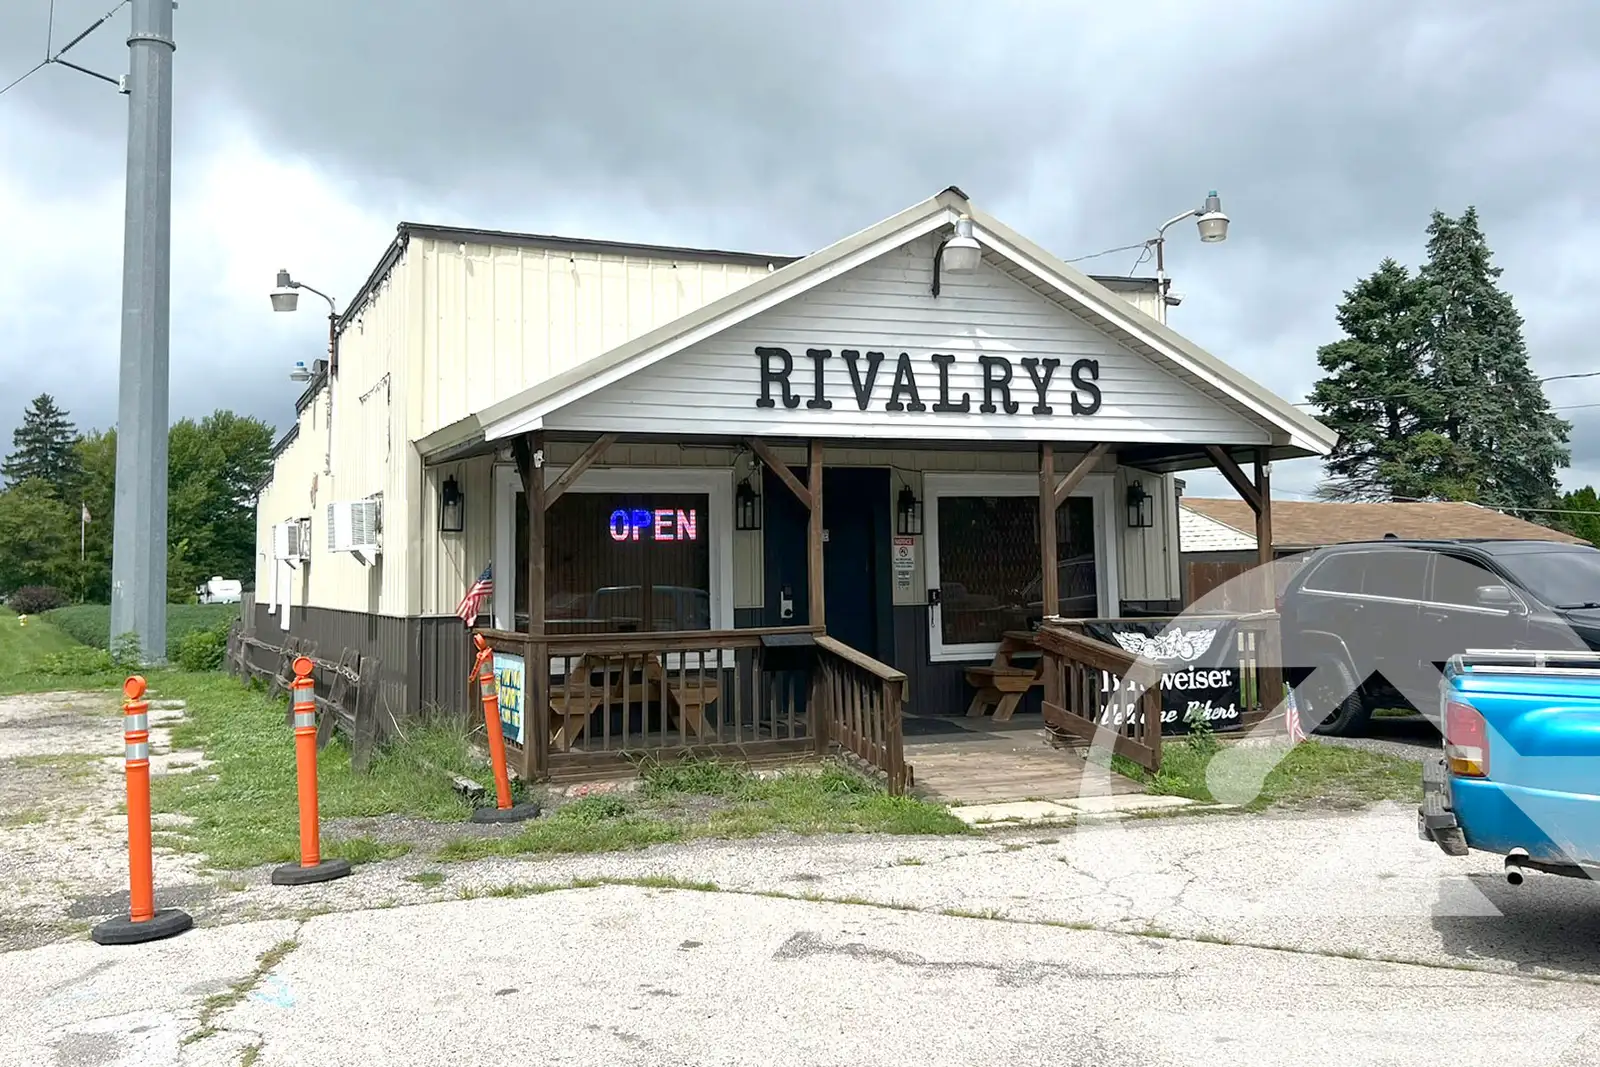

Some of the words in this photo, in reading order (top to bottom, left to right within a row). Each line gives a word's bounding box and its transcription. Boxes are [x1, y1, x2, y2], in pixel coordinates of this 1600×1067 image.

[755, 346, 1101, 416] RIVALRYS
[609, 508, 697, 541] OPEN
[1100, 665, 1231, 693] Bweiser
[1093, 703, 1178, 726] Wele
